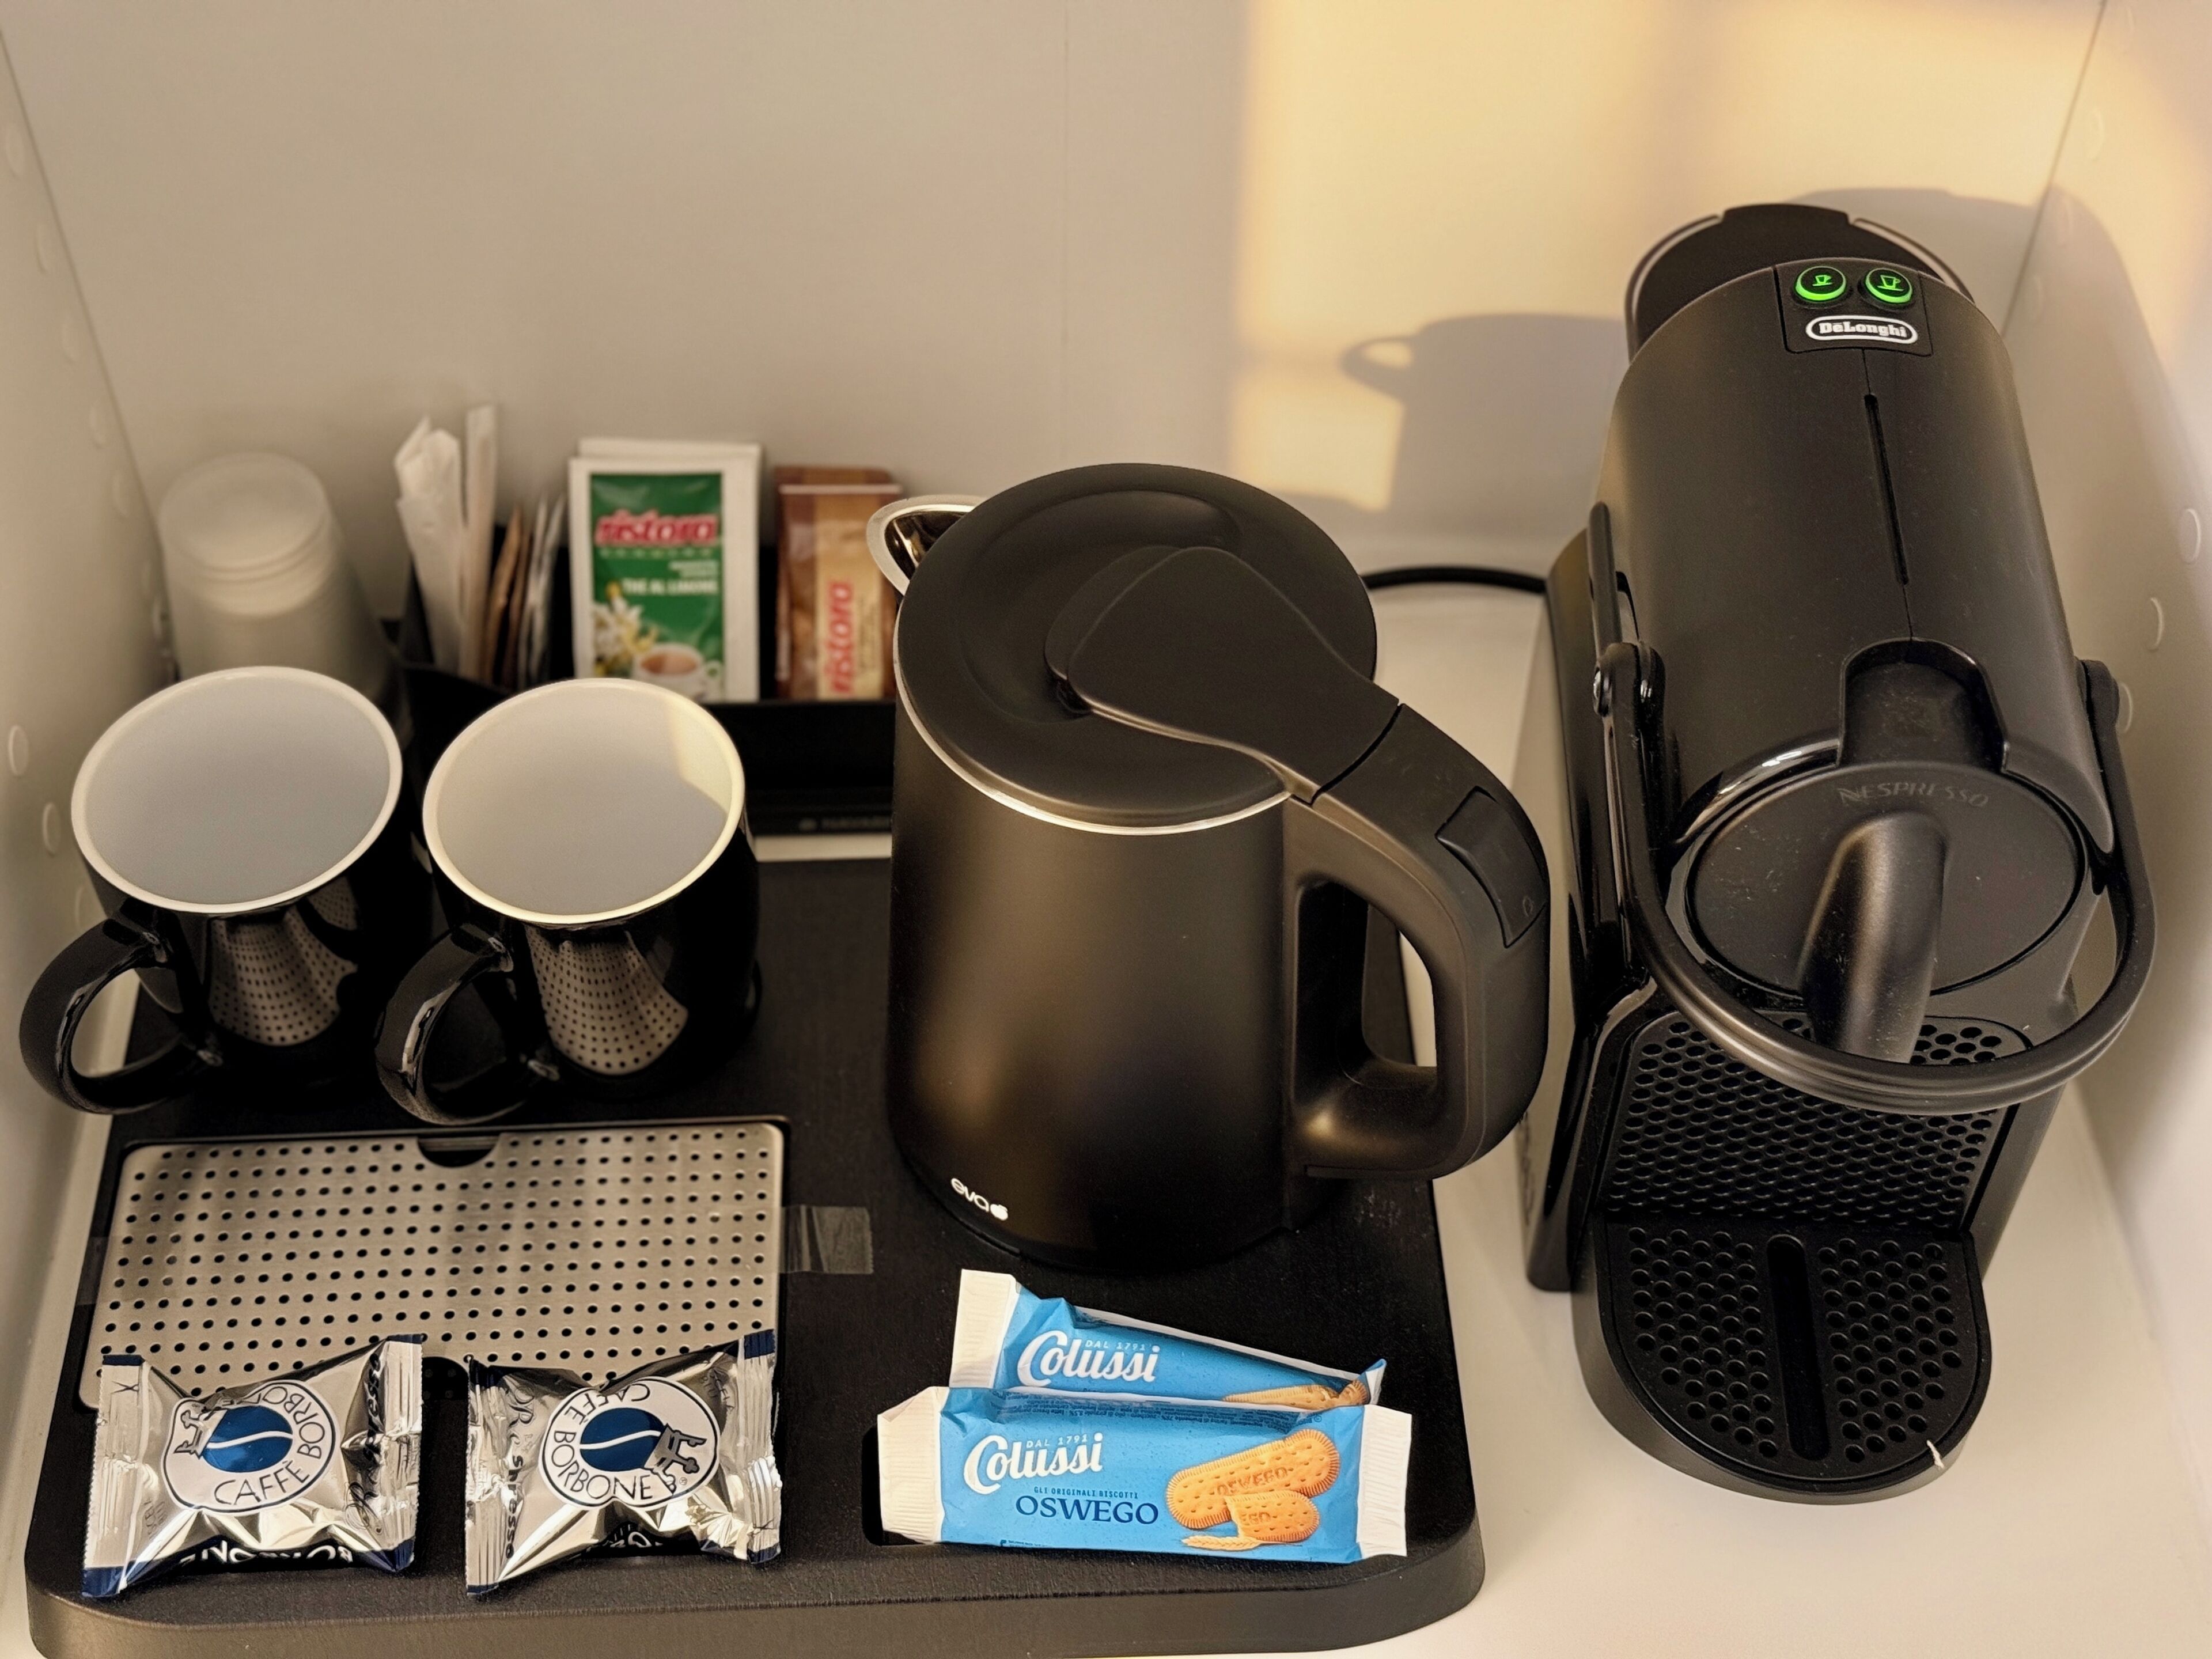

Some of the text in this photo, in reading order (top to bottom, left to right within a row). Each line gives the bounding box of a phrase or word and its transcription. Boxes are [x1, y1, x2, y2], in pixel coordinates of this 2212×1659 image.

[1017, 1330, 1161, 1387] Colussi
[1085, 1339, 1109, 1349] DAL
[1026, 1434, 1088, 1448] DAL 1791
[551, 1430, 653, 1501] BORBONE
[963, 1432, 1103, 1495] Colussi
[214, 1460, 310, 1505] CAFFÈ
[1051, 1487, 1096, 1497] ORIGINALI
[1099, 1490, 1139, 1499] BISCOTTI
[1016, 1495, 1159, 1525] OSWEGO
